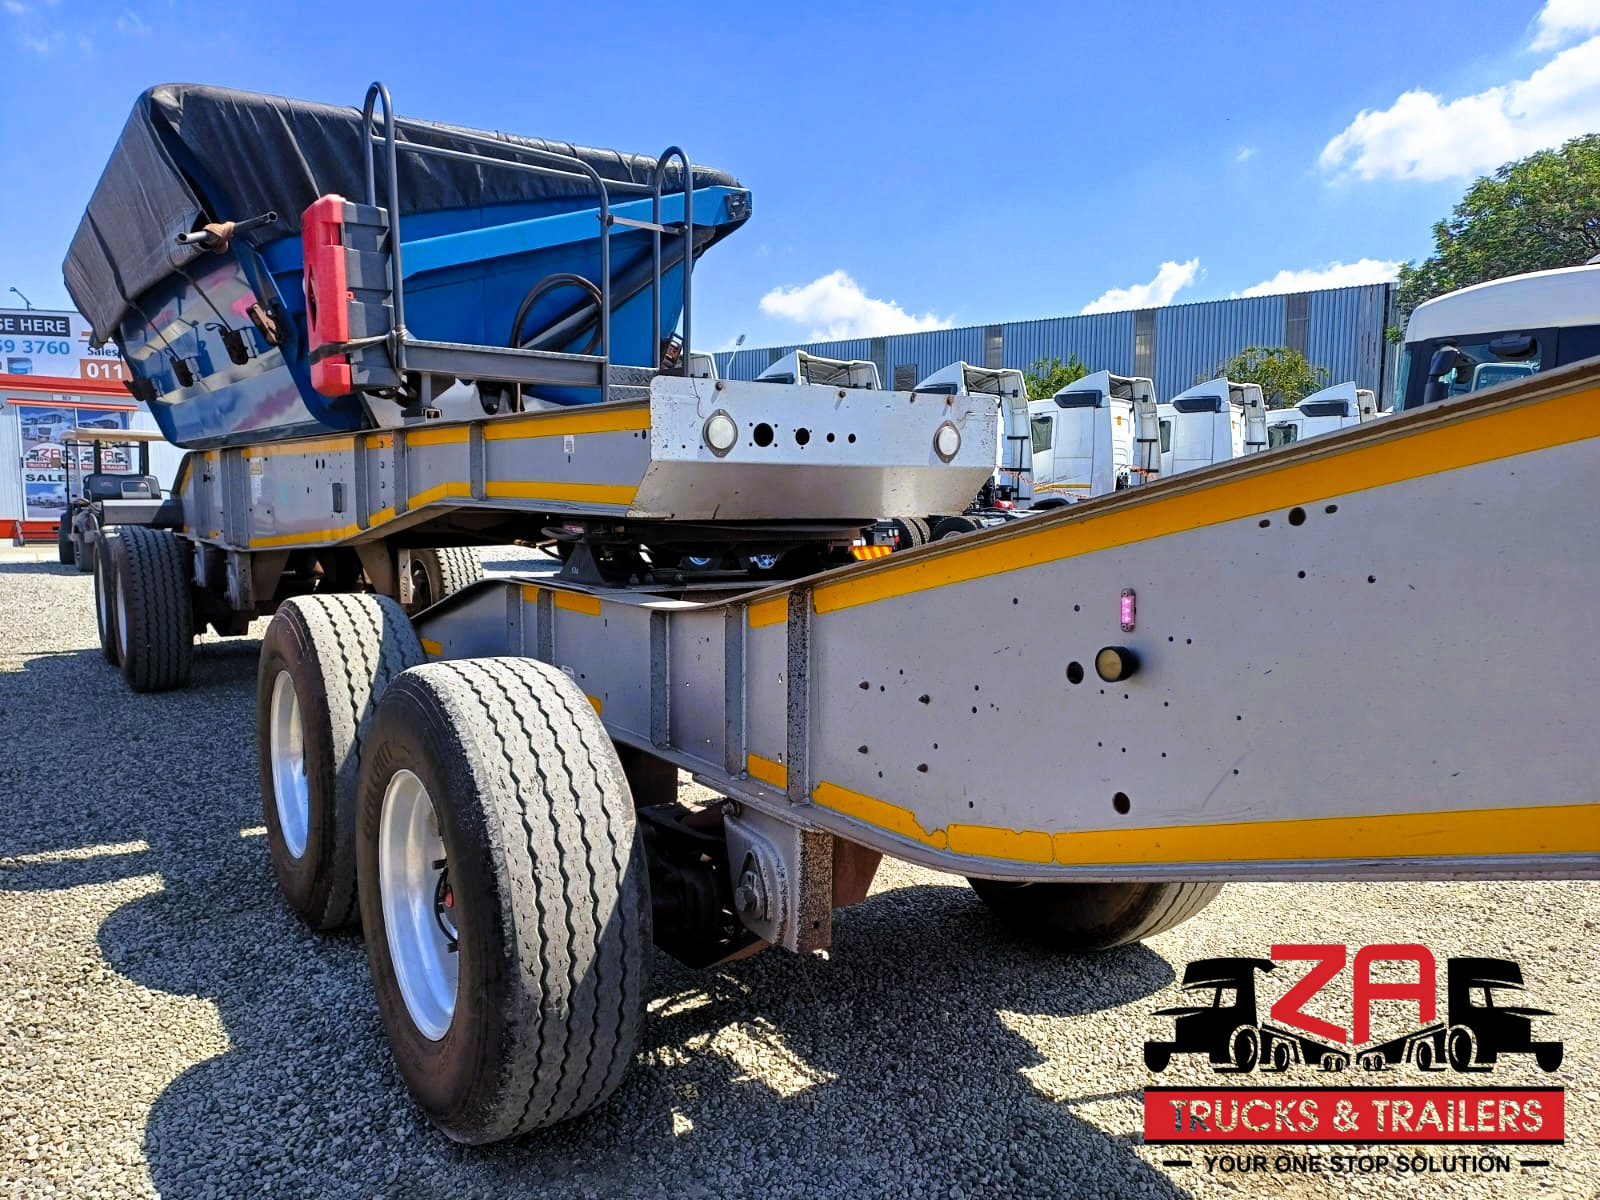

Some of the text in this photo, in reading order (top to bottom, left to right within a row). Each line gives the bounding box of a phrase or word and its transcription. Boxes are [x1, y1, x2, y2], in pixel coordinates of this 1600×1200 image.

[20, 319, 66, 332] HERE
[0, 339, 70, 355] 9 3760
[86, 363, 122, 379] 011
